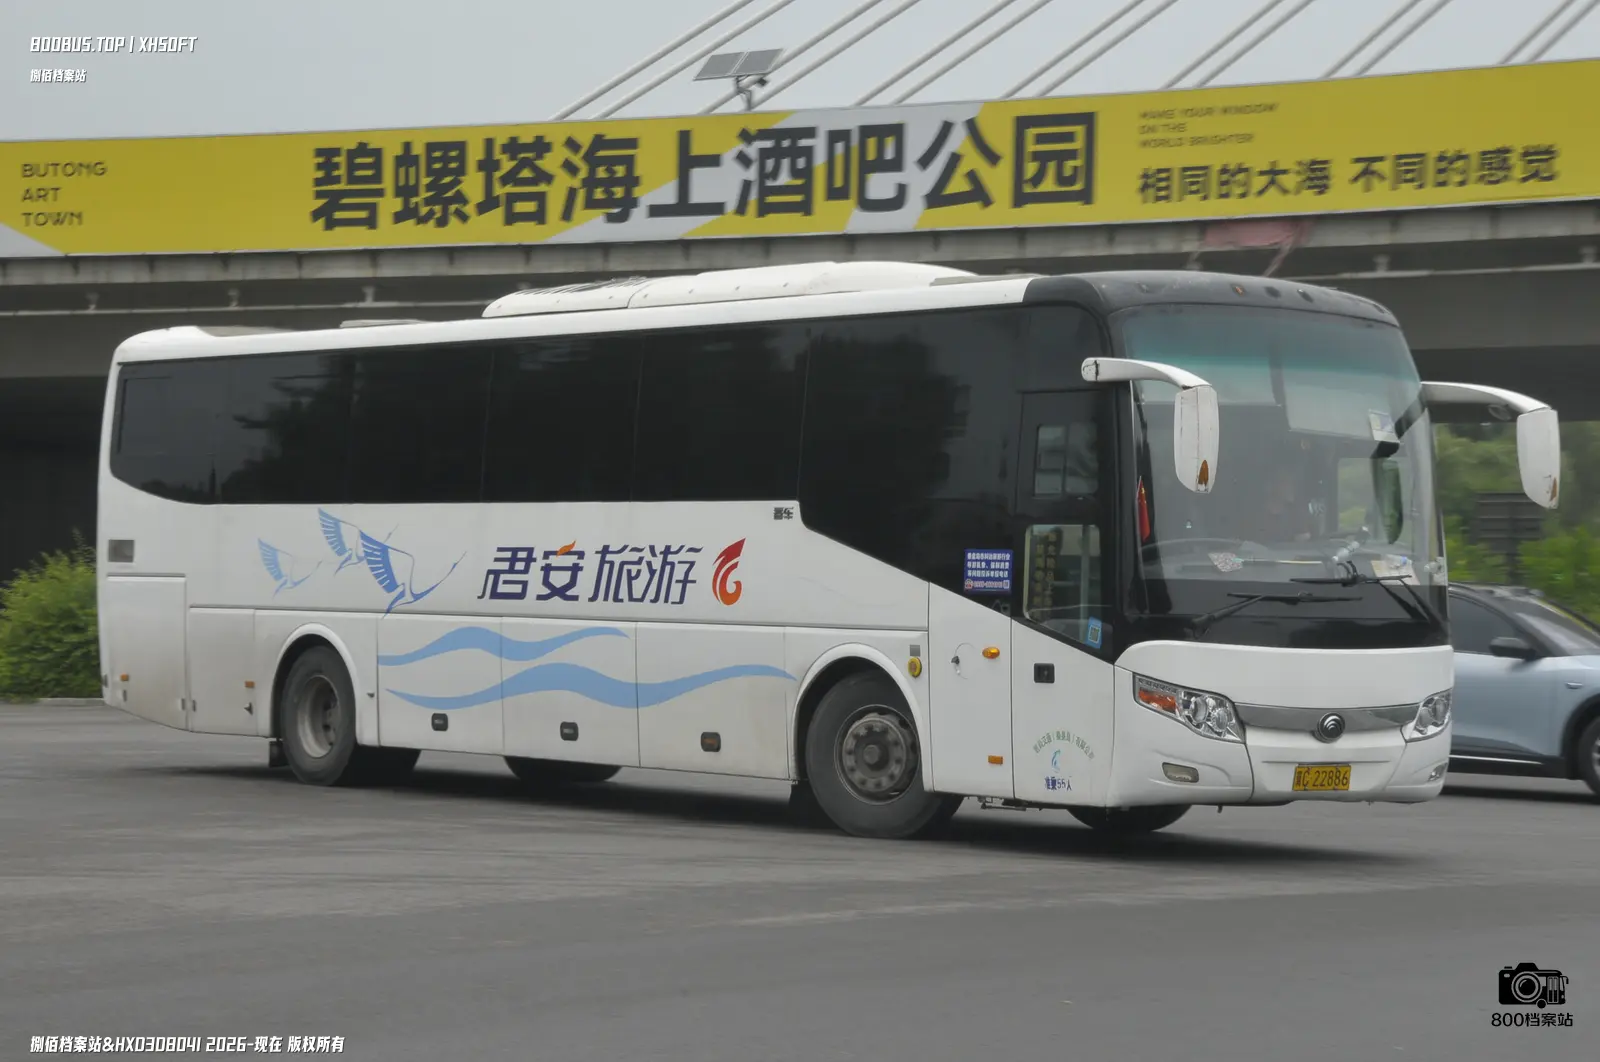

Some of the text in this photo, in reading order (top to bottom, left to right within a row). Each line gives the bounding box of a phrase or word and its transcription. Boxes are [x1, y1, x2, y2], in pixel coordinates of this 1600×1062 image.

[21, 161, 107, 178] BUTONG
[311, 110, 1098, 232] 碧螺塔海上酒吧公园
[1138, 143, 1560, 204] 相同的大海 不同的感觉
[21, 186, 62, 202] ART
[21, 211, 84, 227] TOWN
[477, 539, 704, 605] 君安旅游
